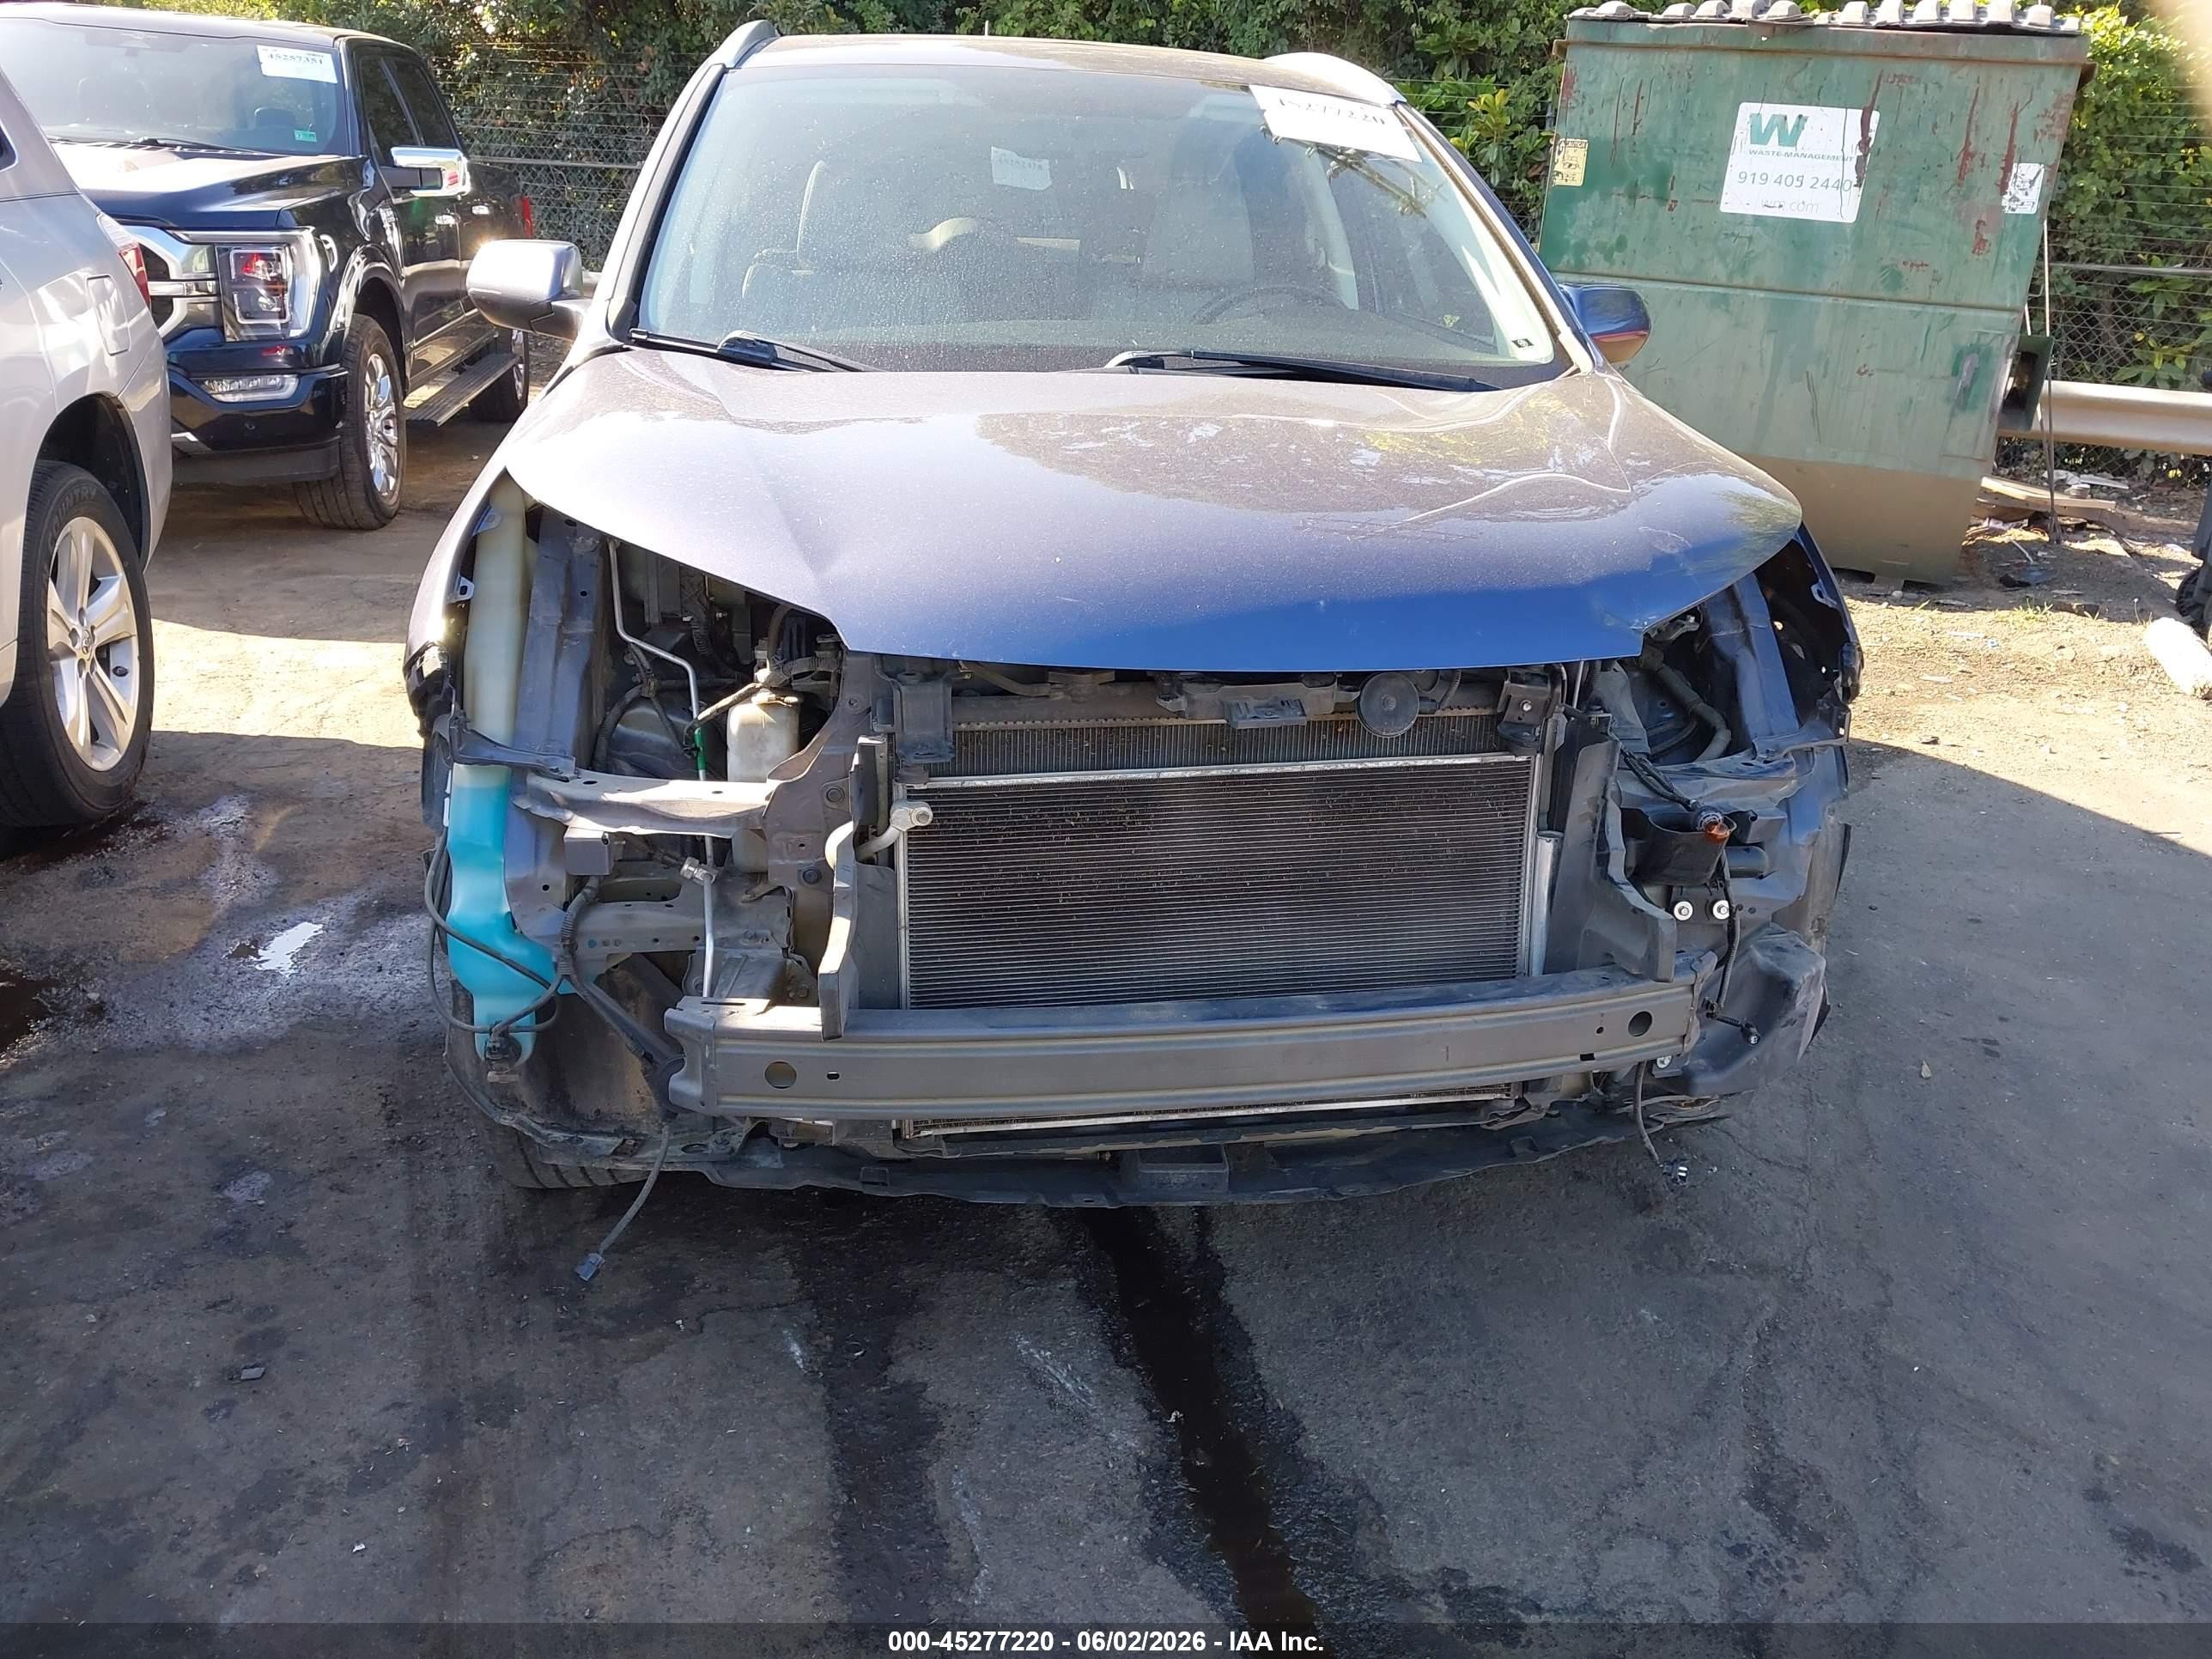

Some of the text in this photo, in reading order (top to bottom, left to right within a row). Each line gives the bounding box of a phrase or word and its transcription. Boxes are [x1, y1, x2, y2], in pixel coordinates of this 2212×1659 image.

[1784, 151, 1855, 162] MANAGEMENT
[1738, 172, 1769, 185] 919
[1809, 177, 1853, 191] 2440
